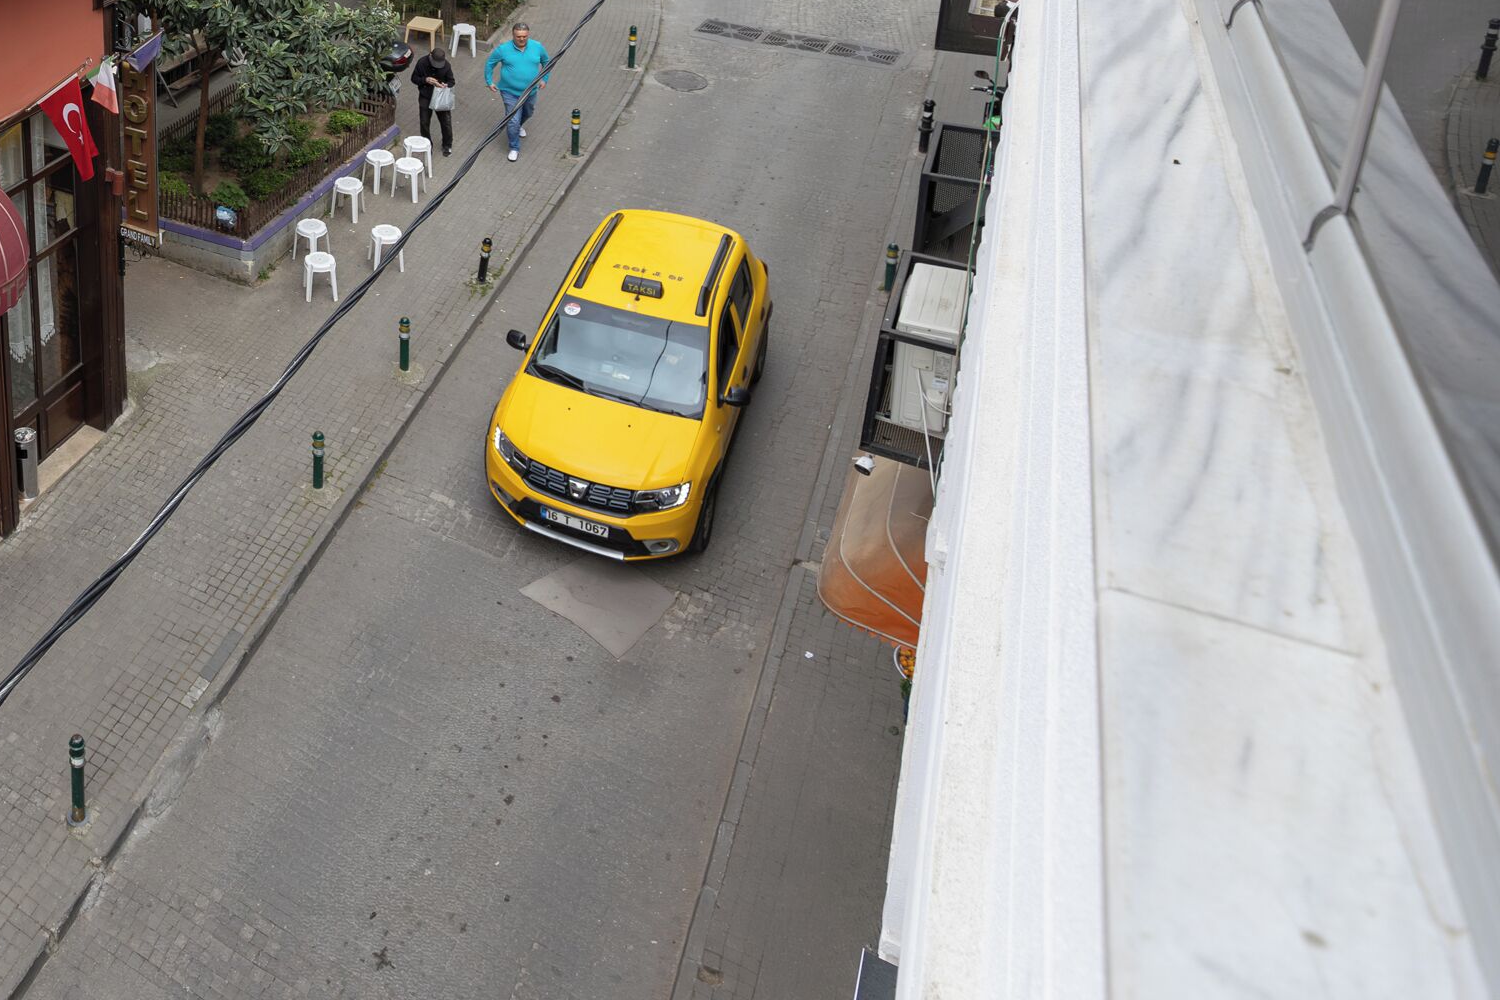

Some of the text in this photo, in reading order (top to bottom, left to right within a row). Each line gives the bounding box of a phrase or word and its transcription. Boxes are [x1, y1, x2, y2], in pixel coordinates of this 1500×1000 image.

[124, 70, 148, 221] HOTEL
[120, 227, 155, 247] GRAND FAMILY
[547, 510, 607, 536] 16 T 1067
